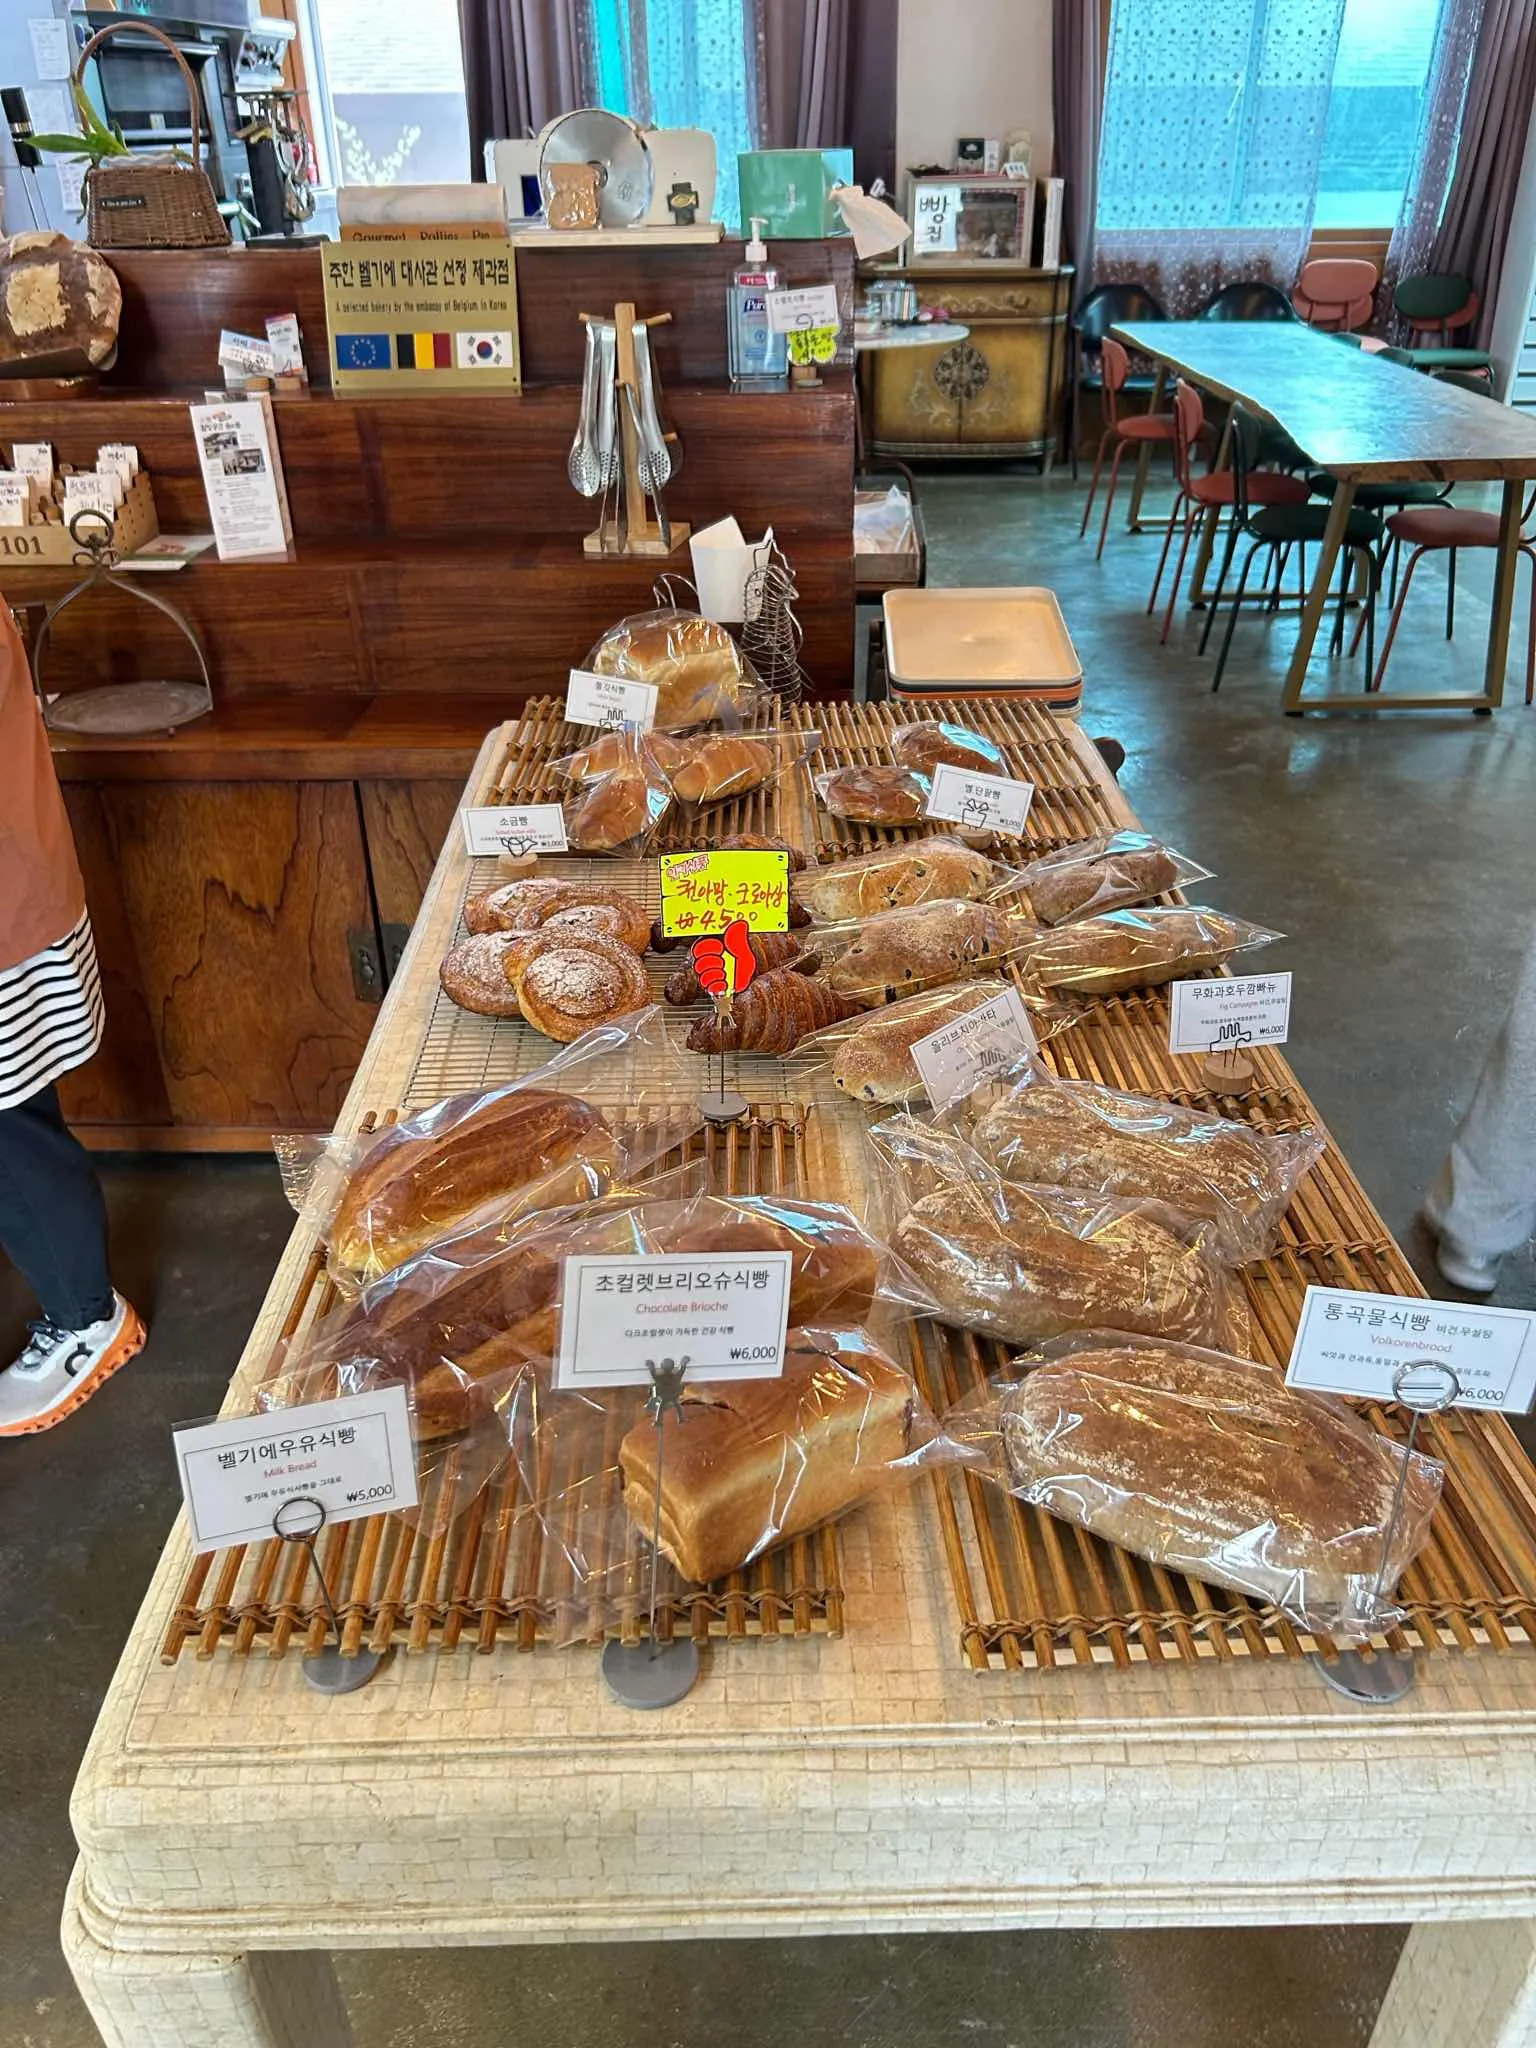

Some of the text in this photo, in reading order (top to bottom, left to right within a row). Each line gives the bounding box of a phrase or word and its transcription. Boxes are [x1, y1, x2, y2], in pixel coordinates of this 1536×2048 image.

[920, 194, 951, 224] 빵
[927, 225, 942, 243] 집
[329, 257, 509, 288] 주한 벨기에 대사관 선정 제과점
[343, 302, 369, 313] selected
[394, 302, 402, 313] by
[404, 301, 414, 312] the
[416, 301, 441, 313] embassy
[444, 300, 451, 311] of
[453, 300, 478, 313] Belgium
[489, 299, 507, 311] Korea
[0, 535, 44, 556] 101
[500, 816, 528, 826] 소금빵
[1192, 982, 1277, 1000] 무화과호두깜빠뉴
[596, 1269, 769, 1293] 초컬렛브리오슈식빵
[636, 1301, 729, 1314] Chocolate Brioche
[1323, 1302, 1431, 1332] 통곡물식빵
[730, 1346, 776, 1360] ₩6,000
[217, 1426, 356, 1469] 벨기에우유식빵
[264, 1461, 317, 1478] Milk Bread
[346, 1484, 393, 1503] ₩5,000
